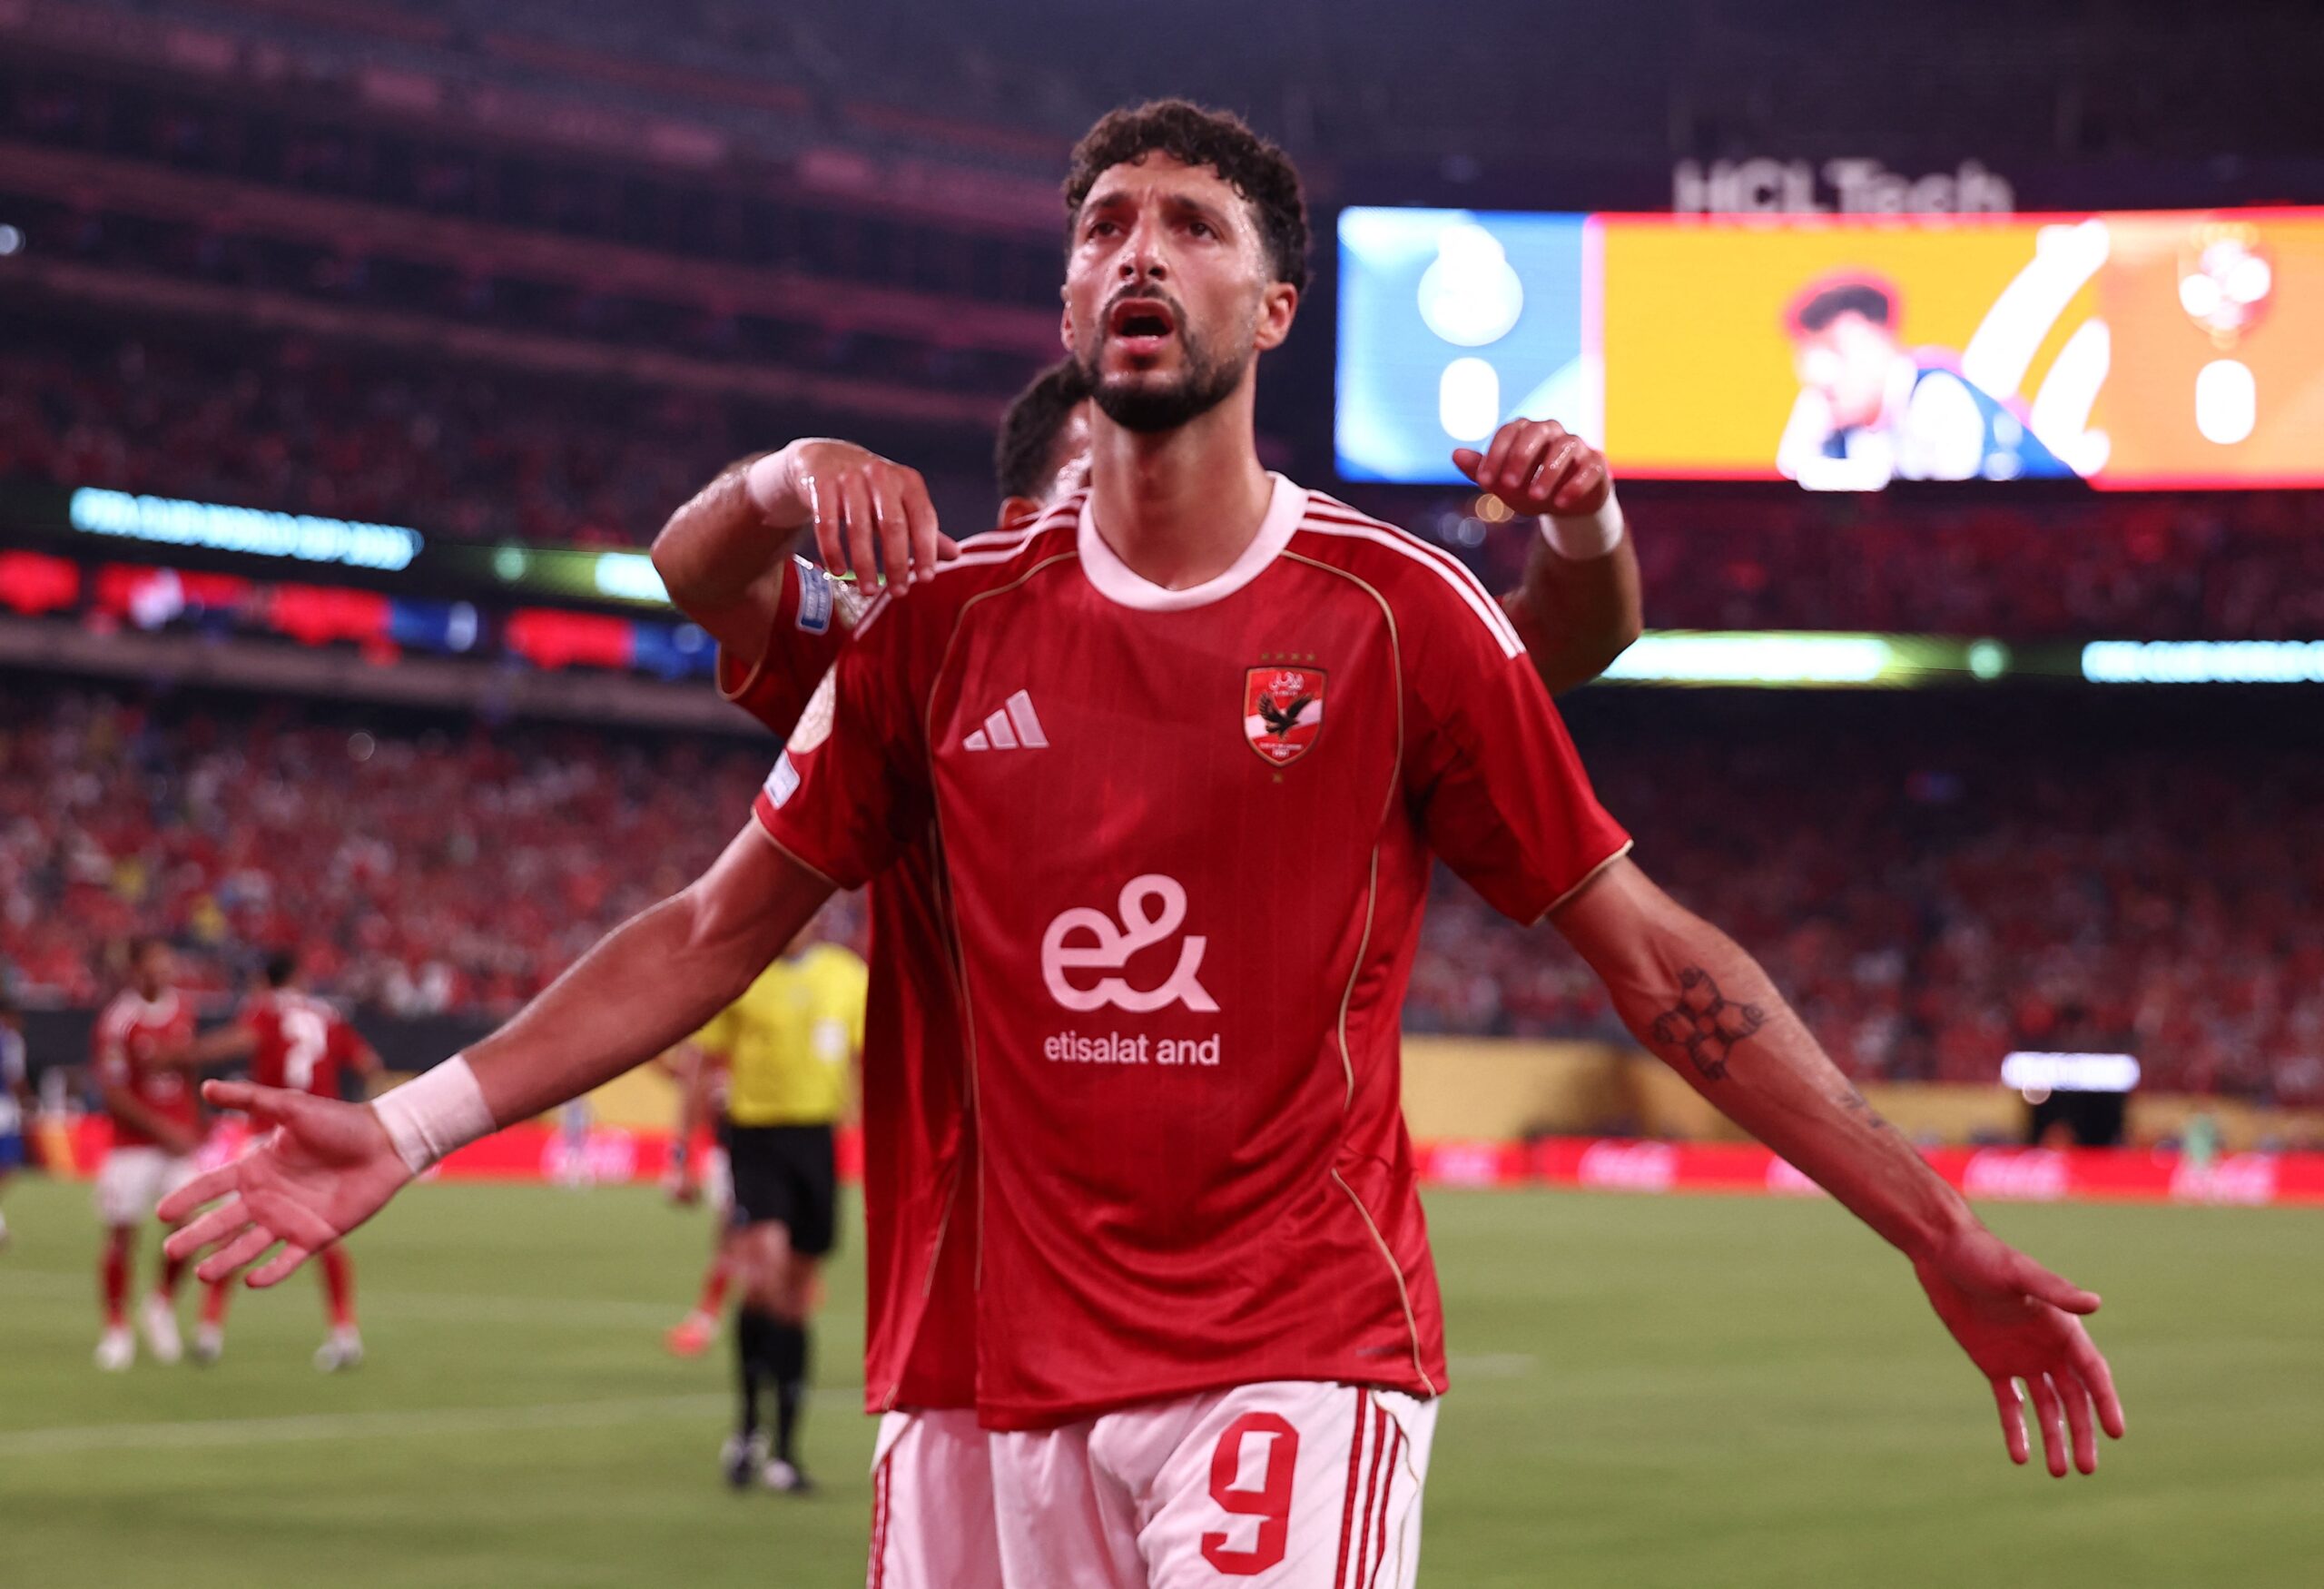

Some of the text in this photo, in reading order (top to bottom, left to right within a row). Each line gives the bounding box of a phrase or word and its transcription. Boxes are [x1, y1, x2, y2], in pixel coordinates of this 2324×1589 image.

[1673, 157, 2013, 223] HCLTech
[1044, 1031, 1220, 1066] etisalat and
[1201, 1412, 1299, 1575] 9
